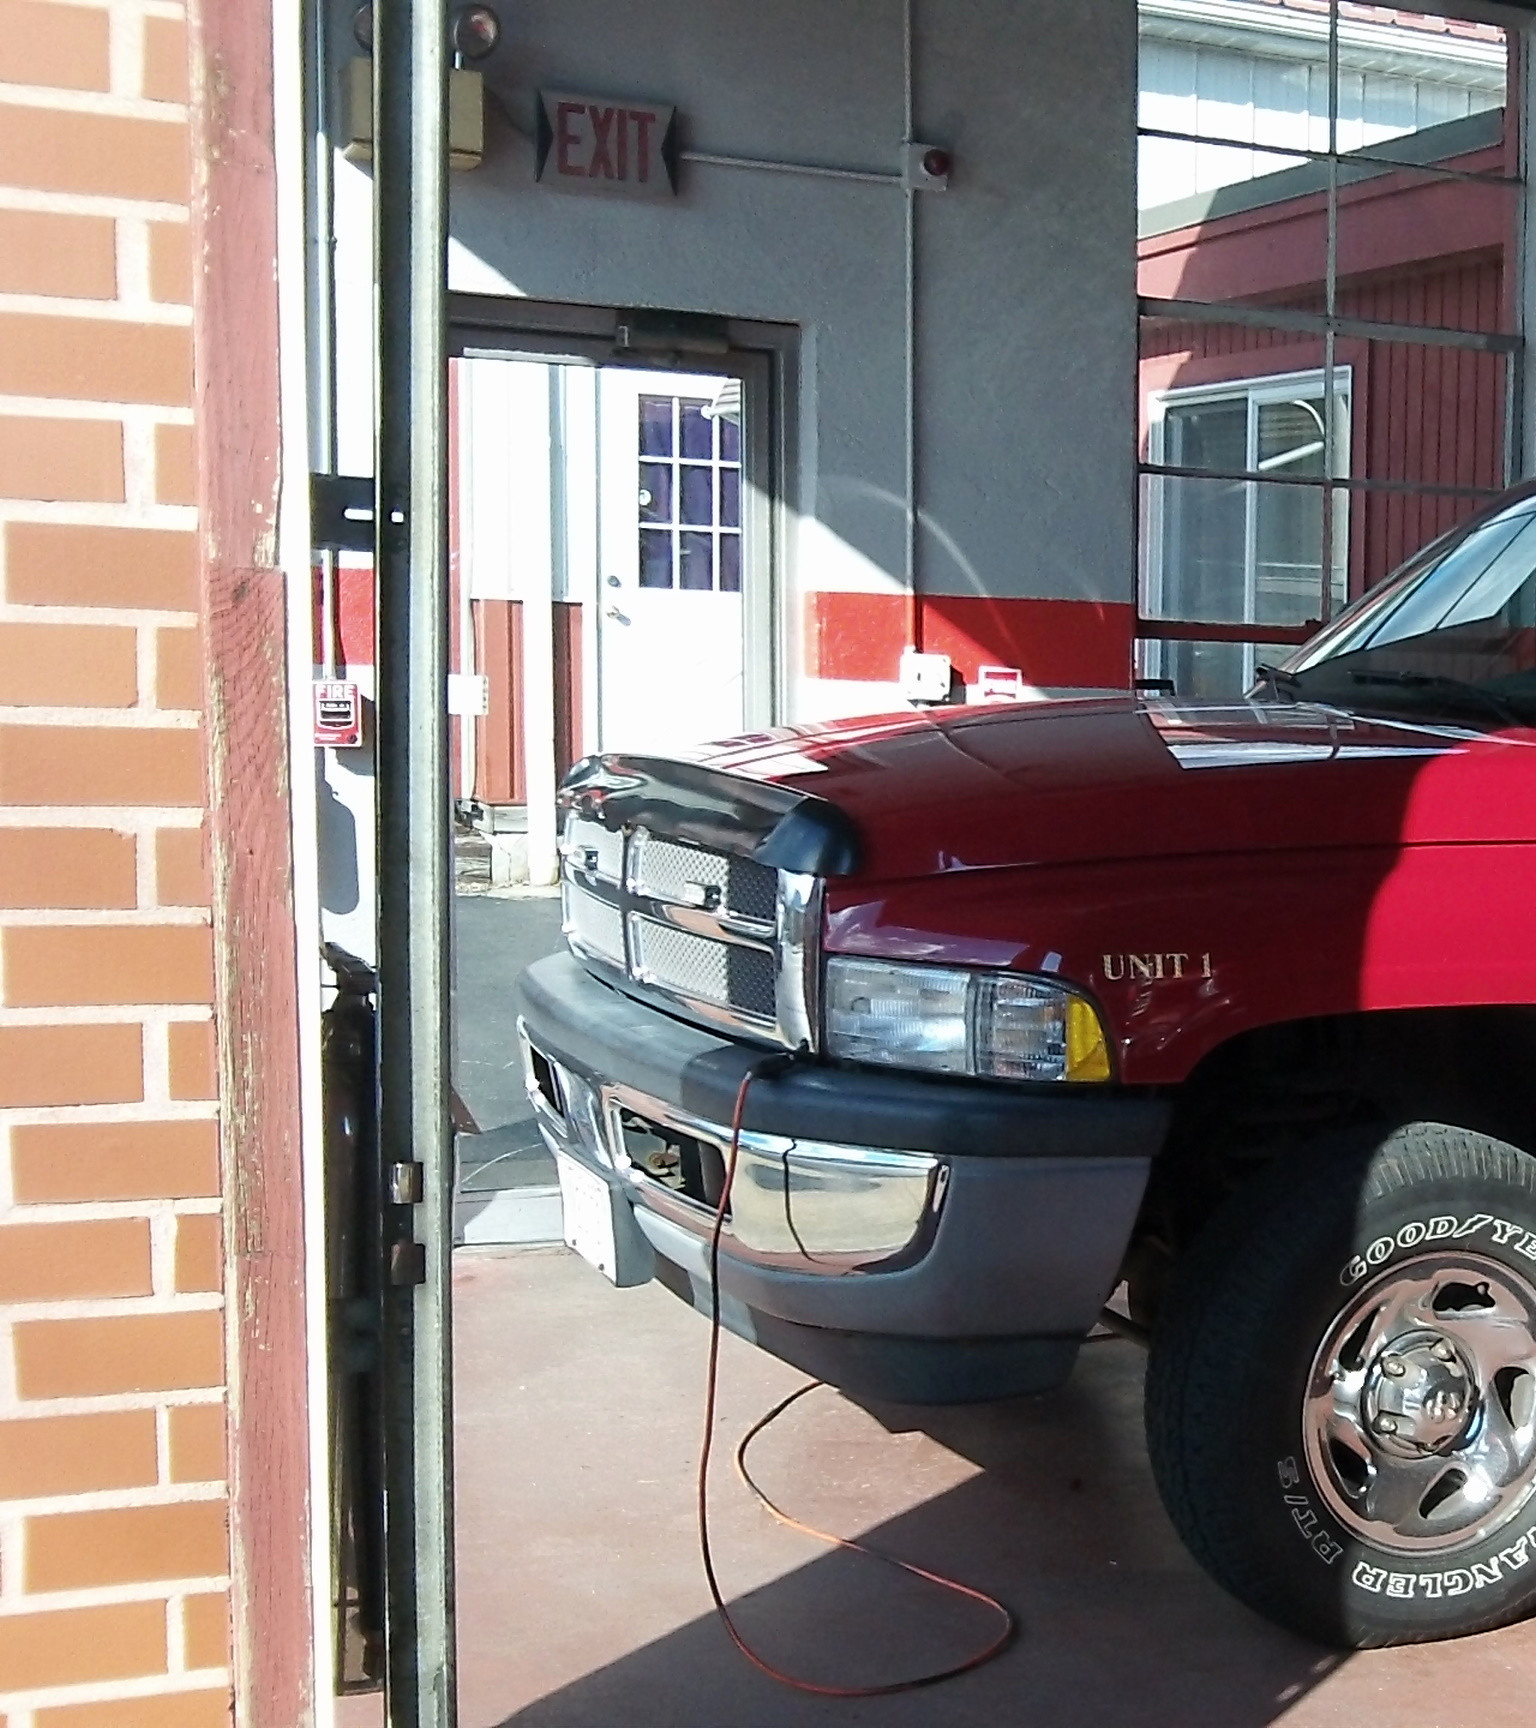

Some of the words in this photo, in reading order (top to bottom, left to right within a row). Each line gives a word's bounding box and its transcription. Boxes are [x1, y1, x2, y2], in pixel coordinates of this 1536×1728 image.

[556, 101, 657, 184] EXIT
[314, 684, 356, 699] FIRE
[1102, 953, 1189, 981] UNIT
[1200, 952, 1213, 979] 1
[1277, 1455, 1344, 1565] RT/S
